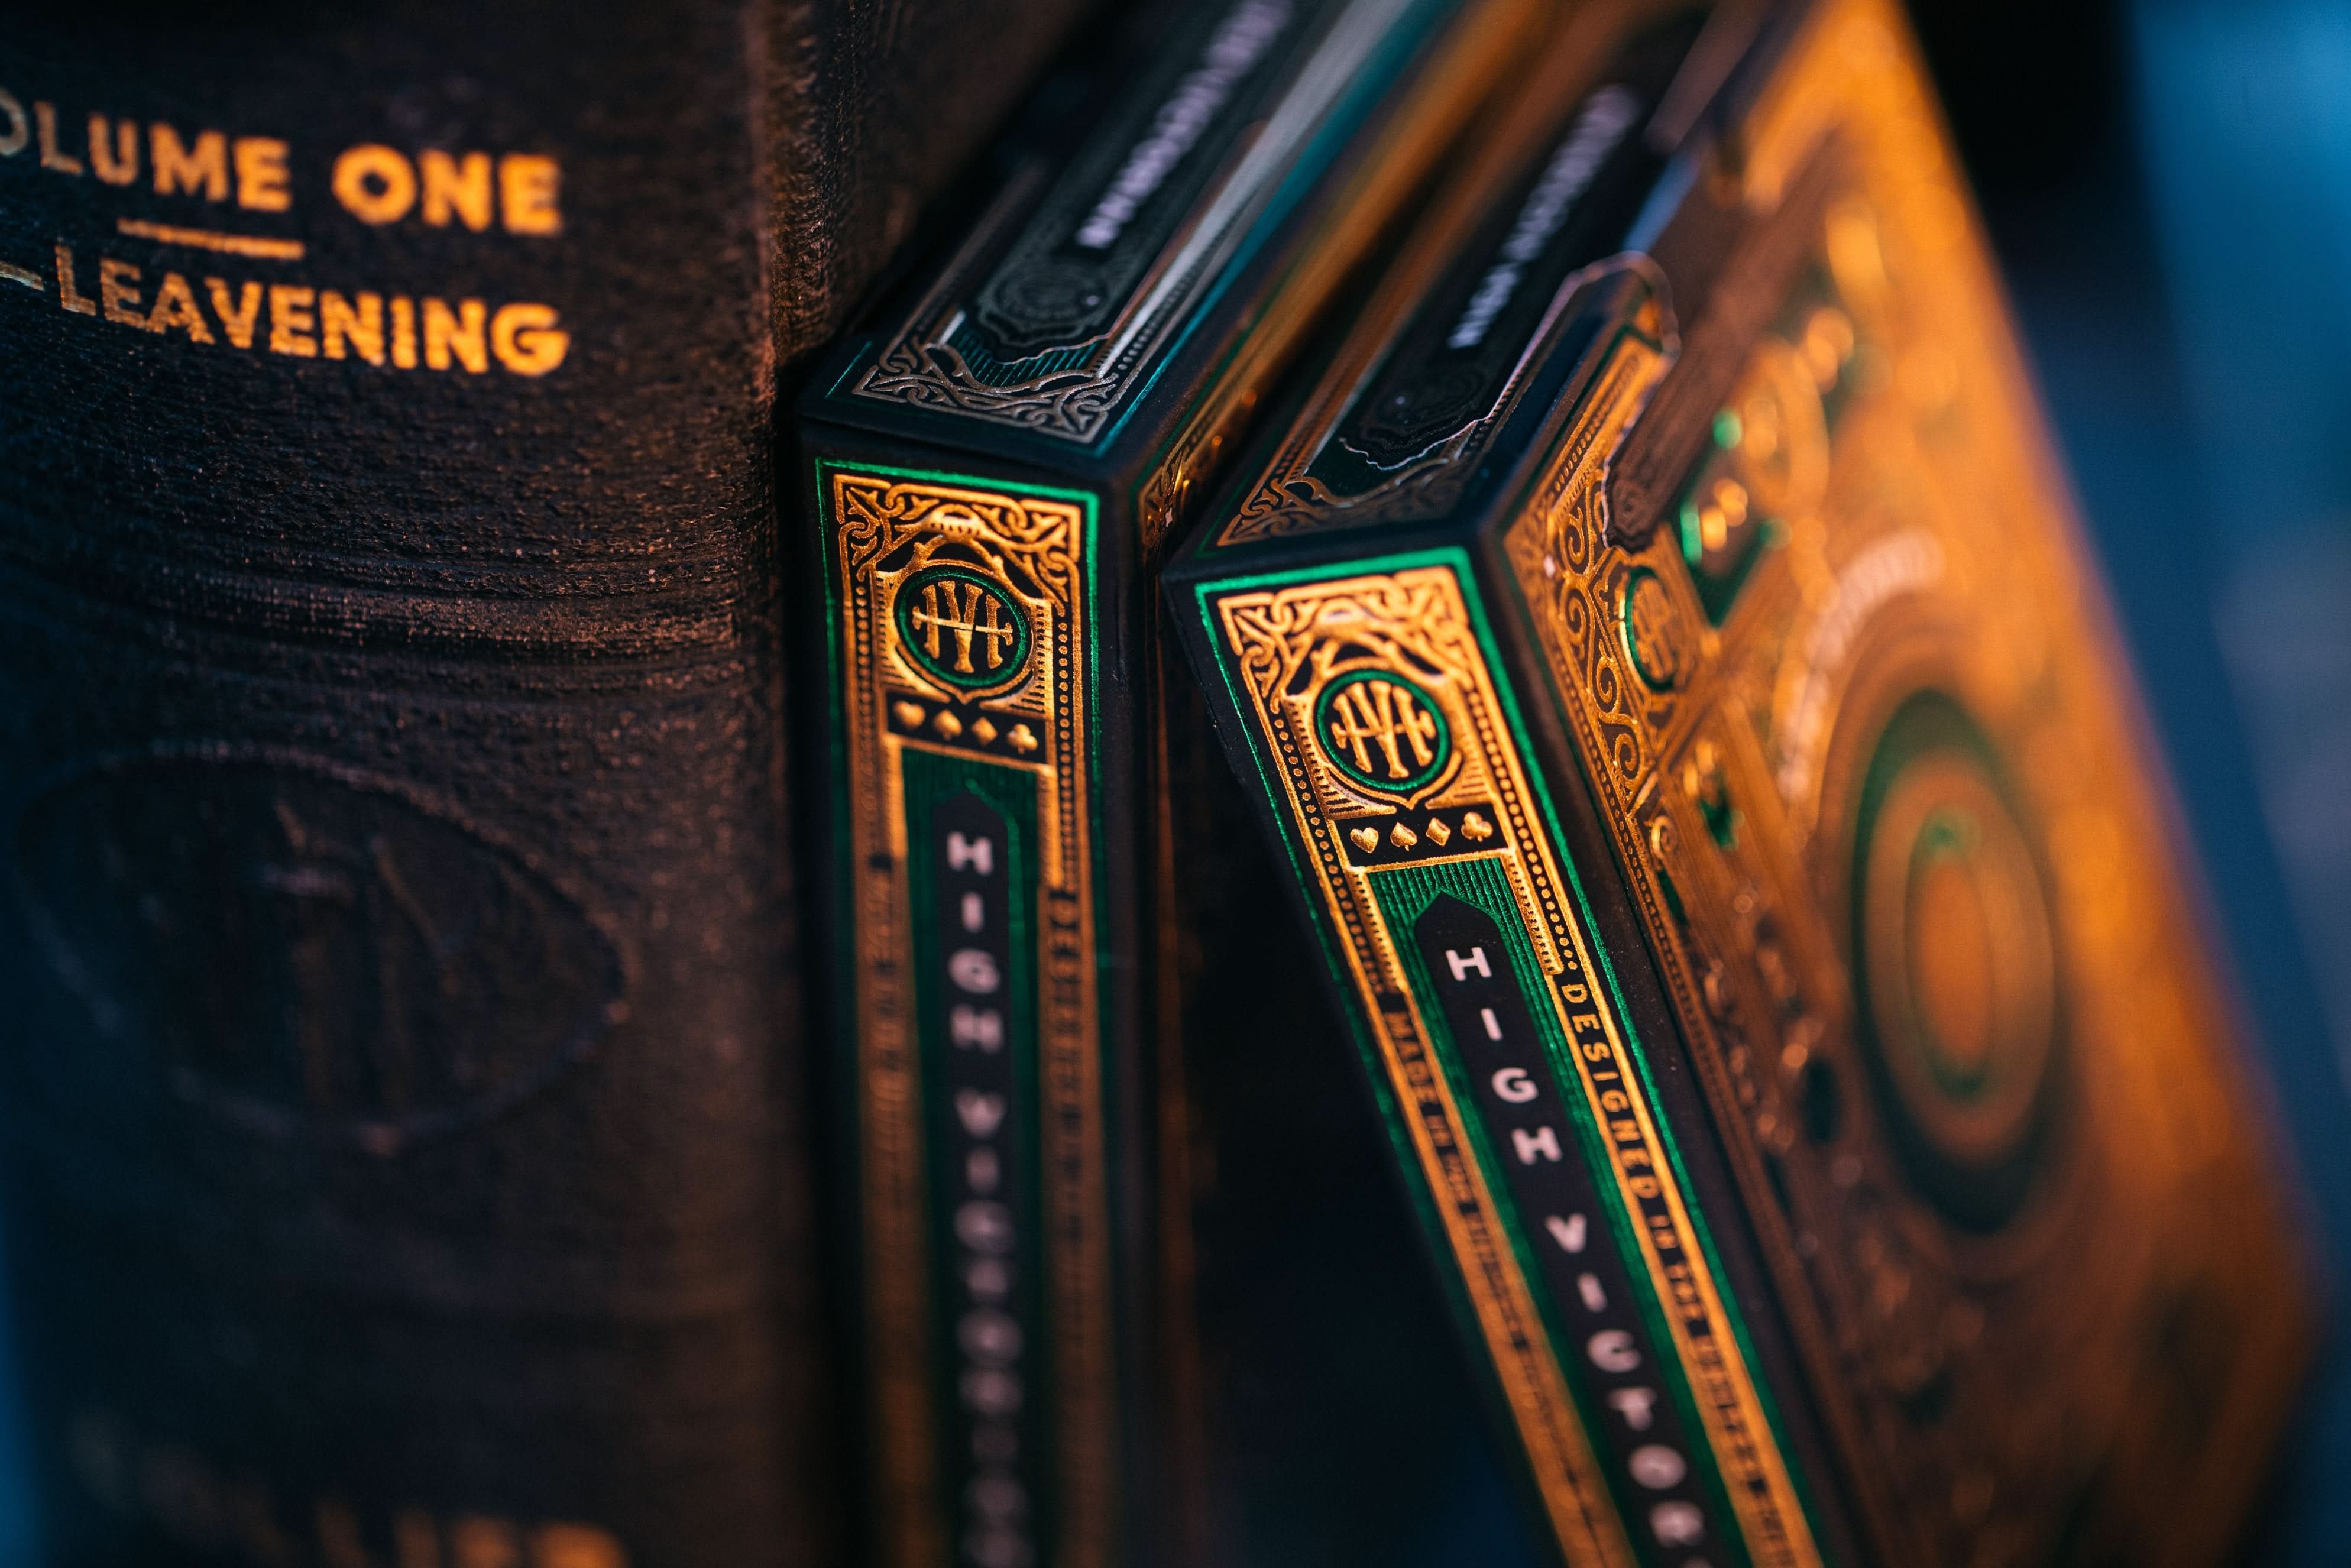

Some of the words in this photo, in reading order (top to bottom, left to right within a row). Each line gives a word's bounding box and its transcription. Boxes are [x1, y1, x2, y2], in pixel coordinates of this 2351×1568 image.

[332, 144, 561, 234] ONE
[56, 245, 569, 376] LEAVENING
[1446, 947, 1562, 1165] HIGH
[1562, 983, 1660, 1199] DESIGNED
